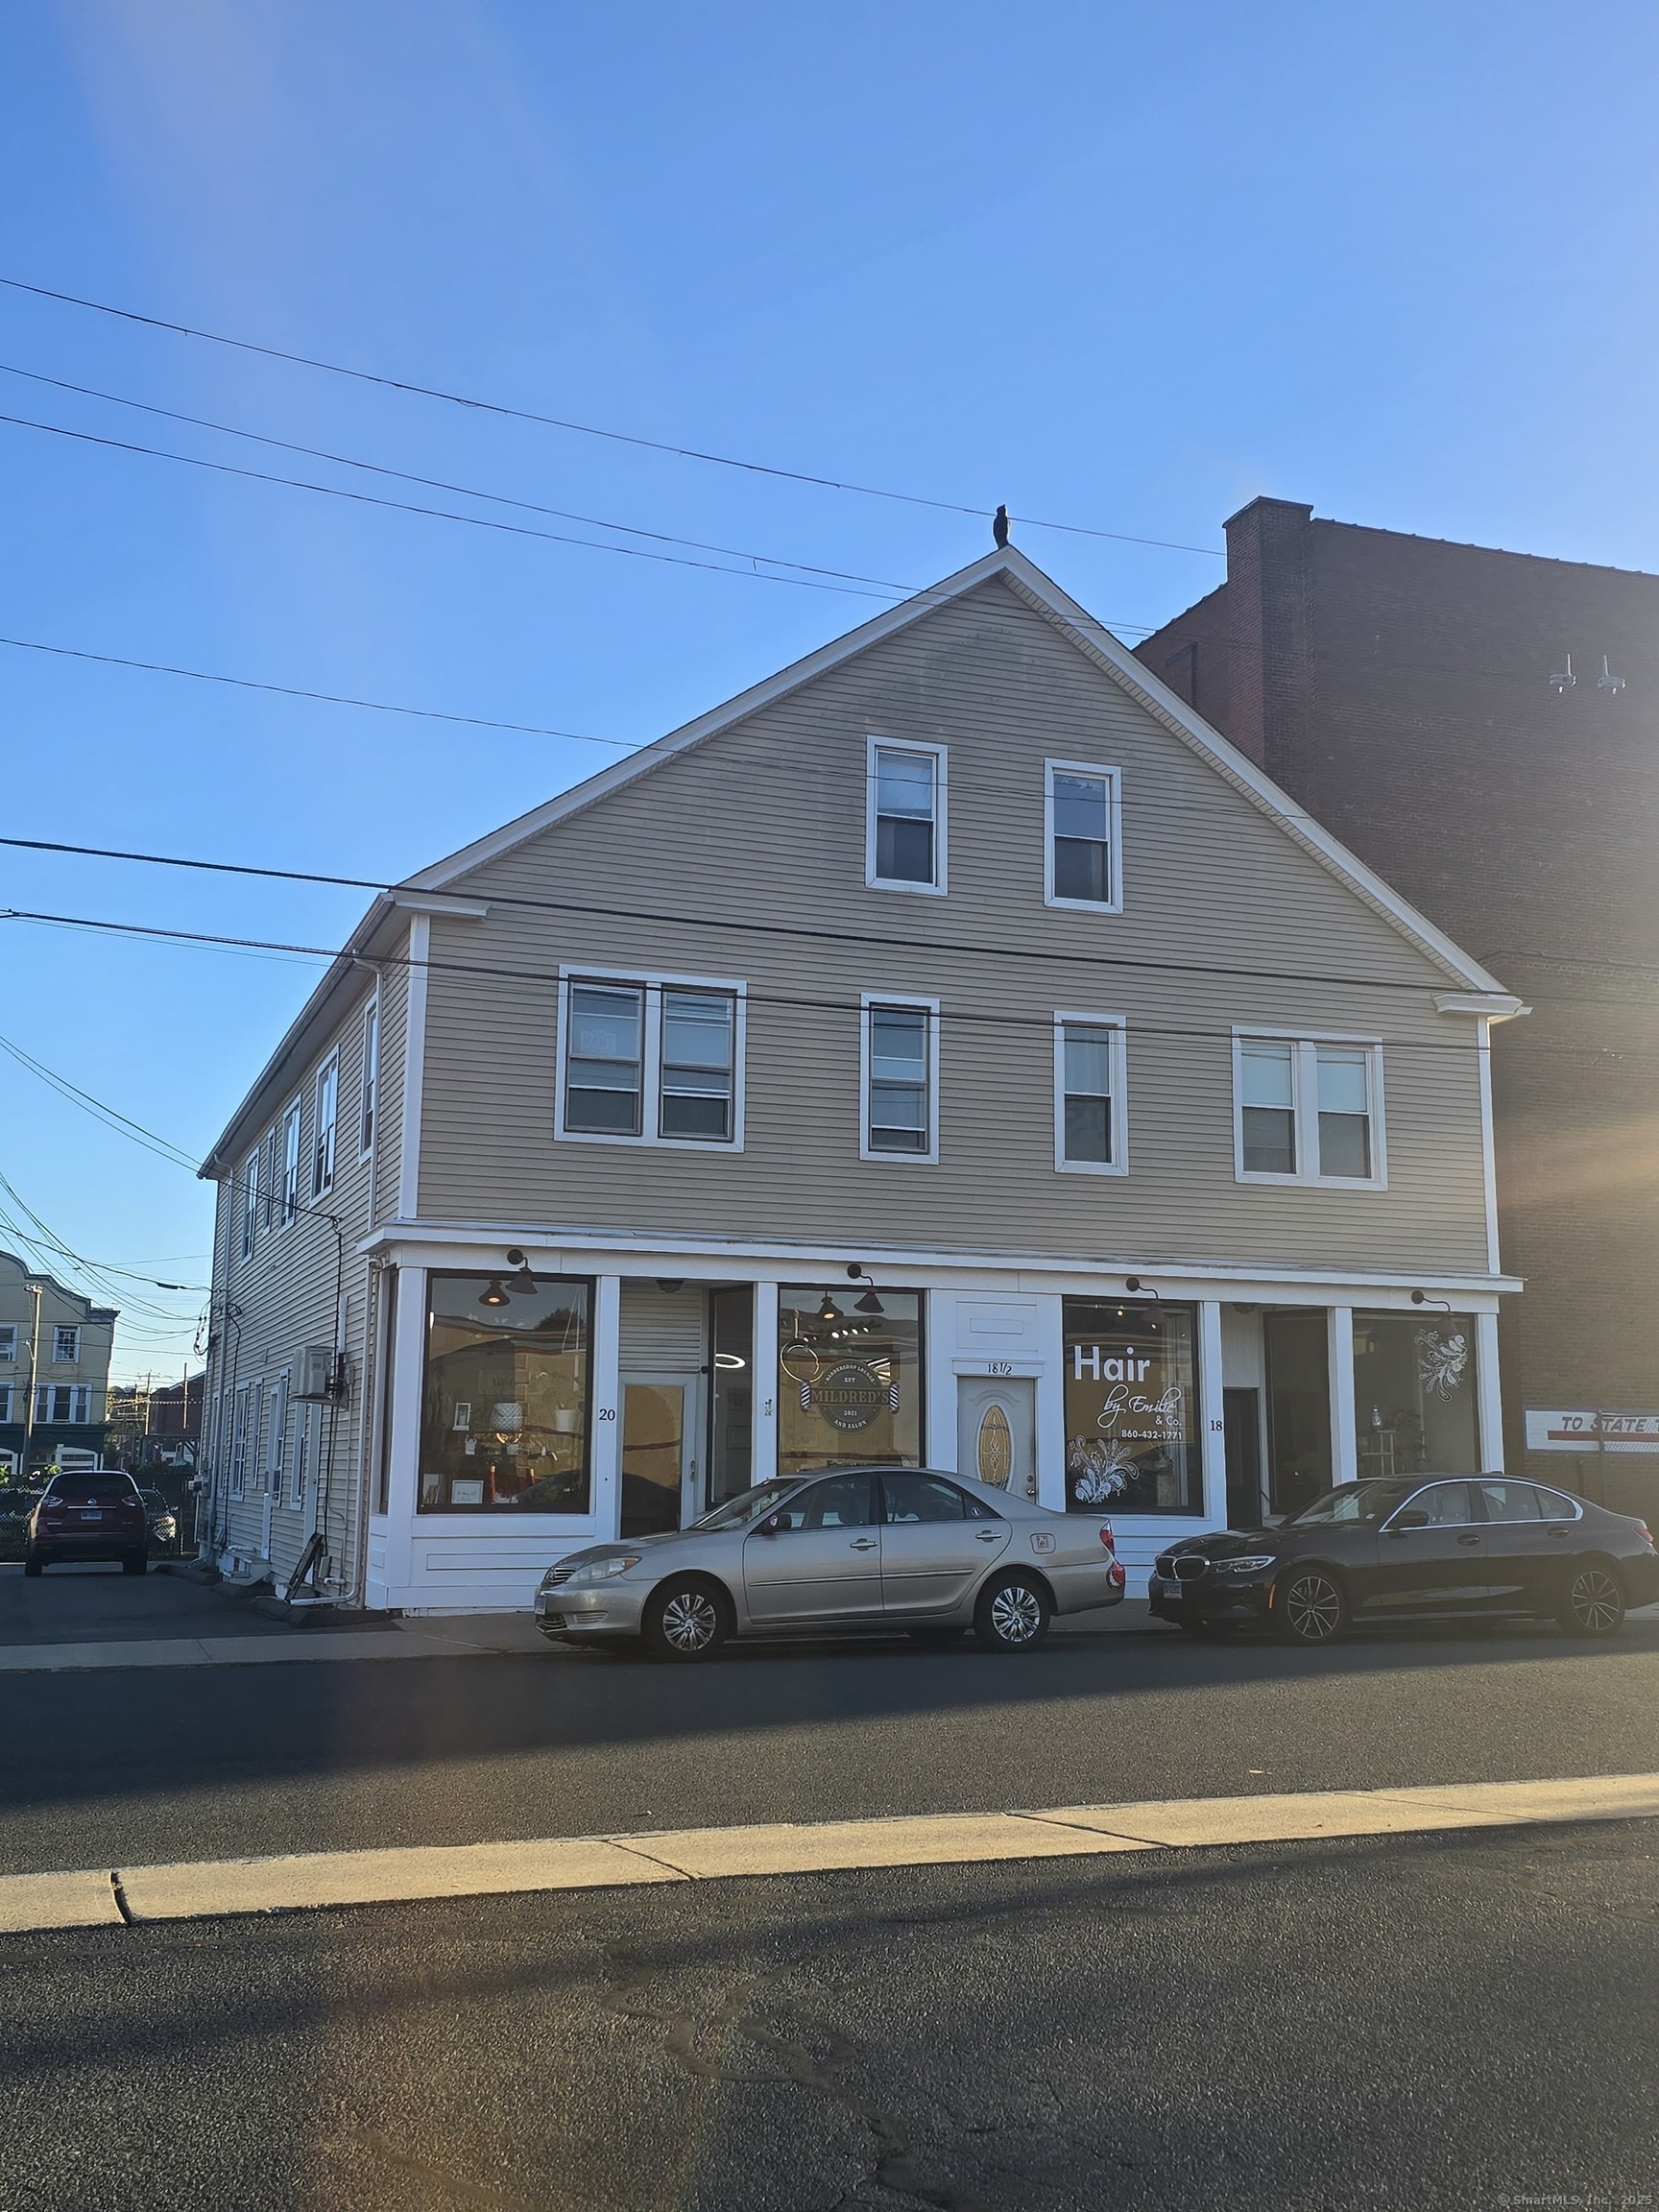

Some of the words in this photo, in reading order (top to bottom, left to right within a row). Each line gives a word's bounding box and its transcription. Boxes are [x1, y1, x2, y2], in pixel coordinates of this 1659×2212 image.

[987, 1363, 998, 1374] 18
[1074, 1345, 1150, 1382] Hair
[826, 1364, 857, 1382] BARBERSHOP
[812, 1390, 888, 1403] MILDRED'S
[1097, 1383, 1129, 1429] by
[599, 1408, 615, 1421] 20
[1155, 1415, 1164, 1426] &
[1166, 1415, 1182, 1427] Co.
[833, 1419, 847, 1429] AND
[847, 1420, 867, 1430] SALON
[1210, 1420, 1223, 1431] 18
[1561, 1416, 1583, 1431] TO
[1590, 1418, 1647, 1432] STATE
[1121, 1430, 1182, 1440] 860-432-1771
